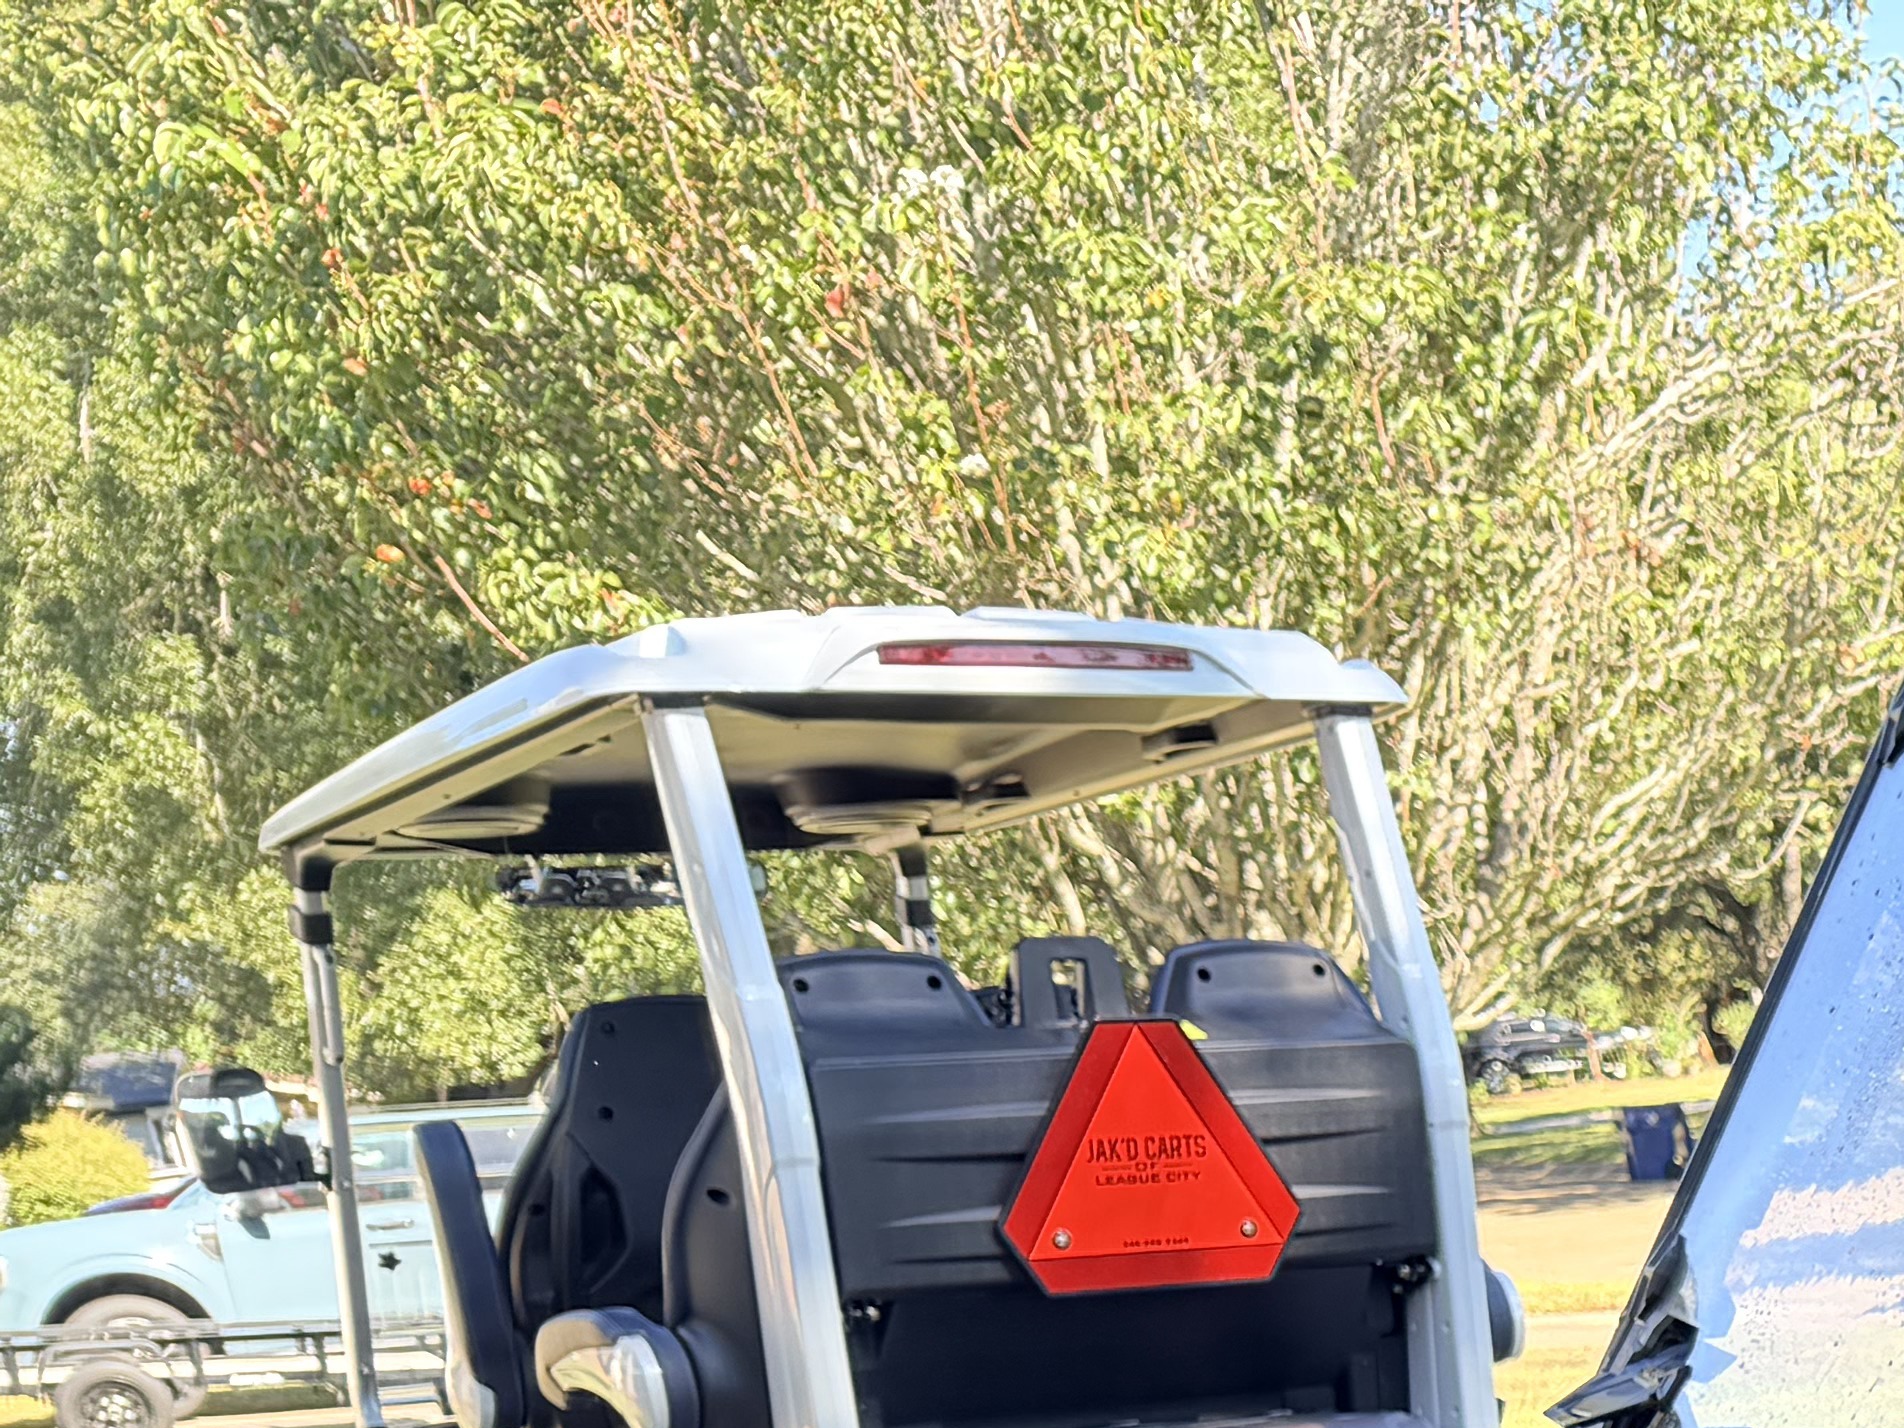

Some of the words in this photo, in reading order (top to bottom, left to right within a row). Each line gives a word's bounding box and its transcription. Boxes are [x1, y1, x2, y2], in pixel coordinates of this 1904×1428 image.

[1087, 1136, 1139, 1163] JAK'D
[1144, 1134, 1206, 1161] CARTS
[1135, 1161, 1159, 1172] OF
[1095, 1172, 1160, 1186] LEAGUE
[1166, 1170, 1201, 1183] CITY
